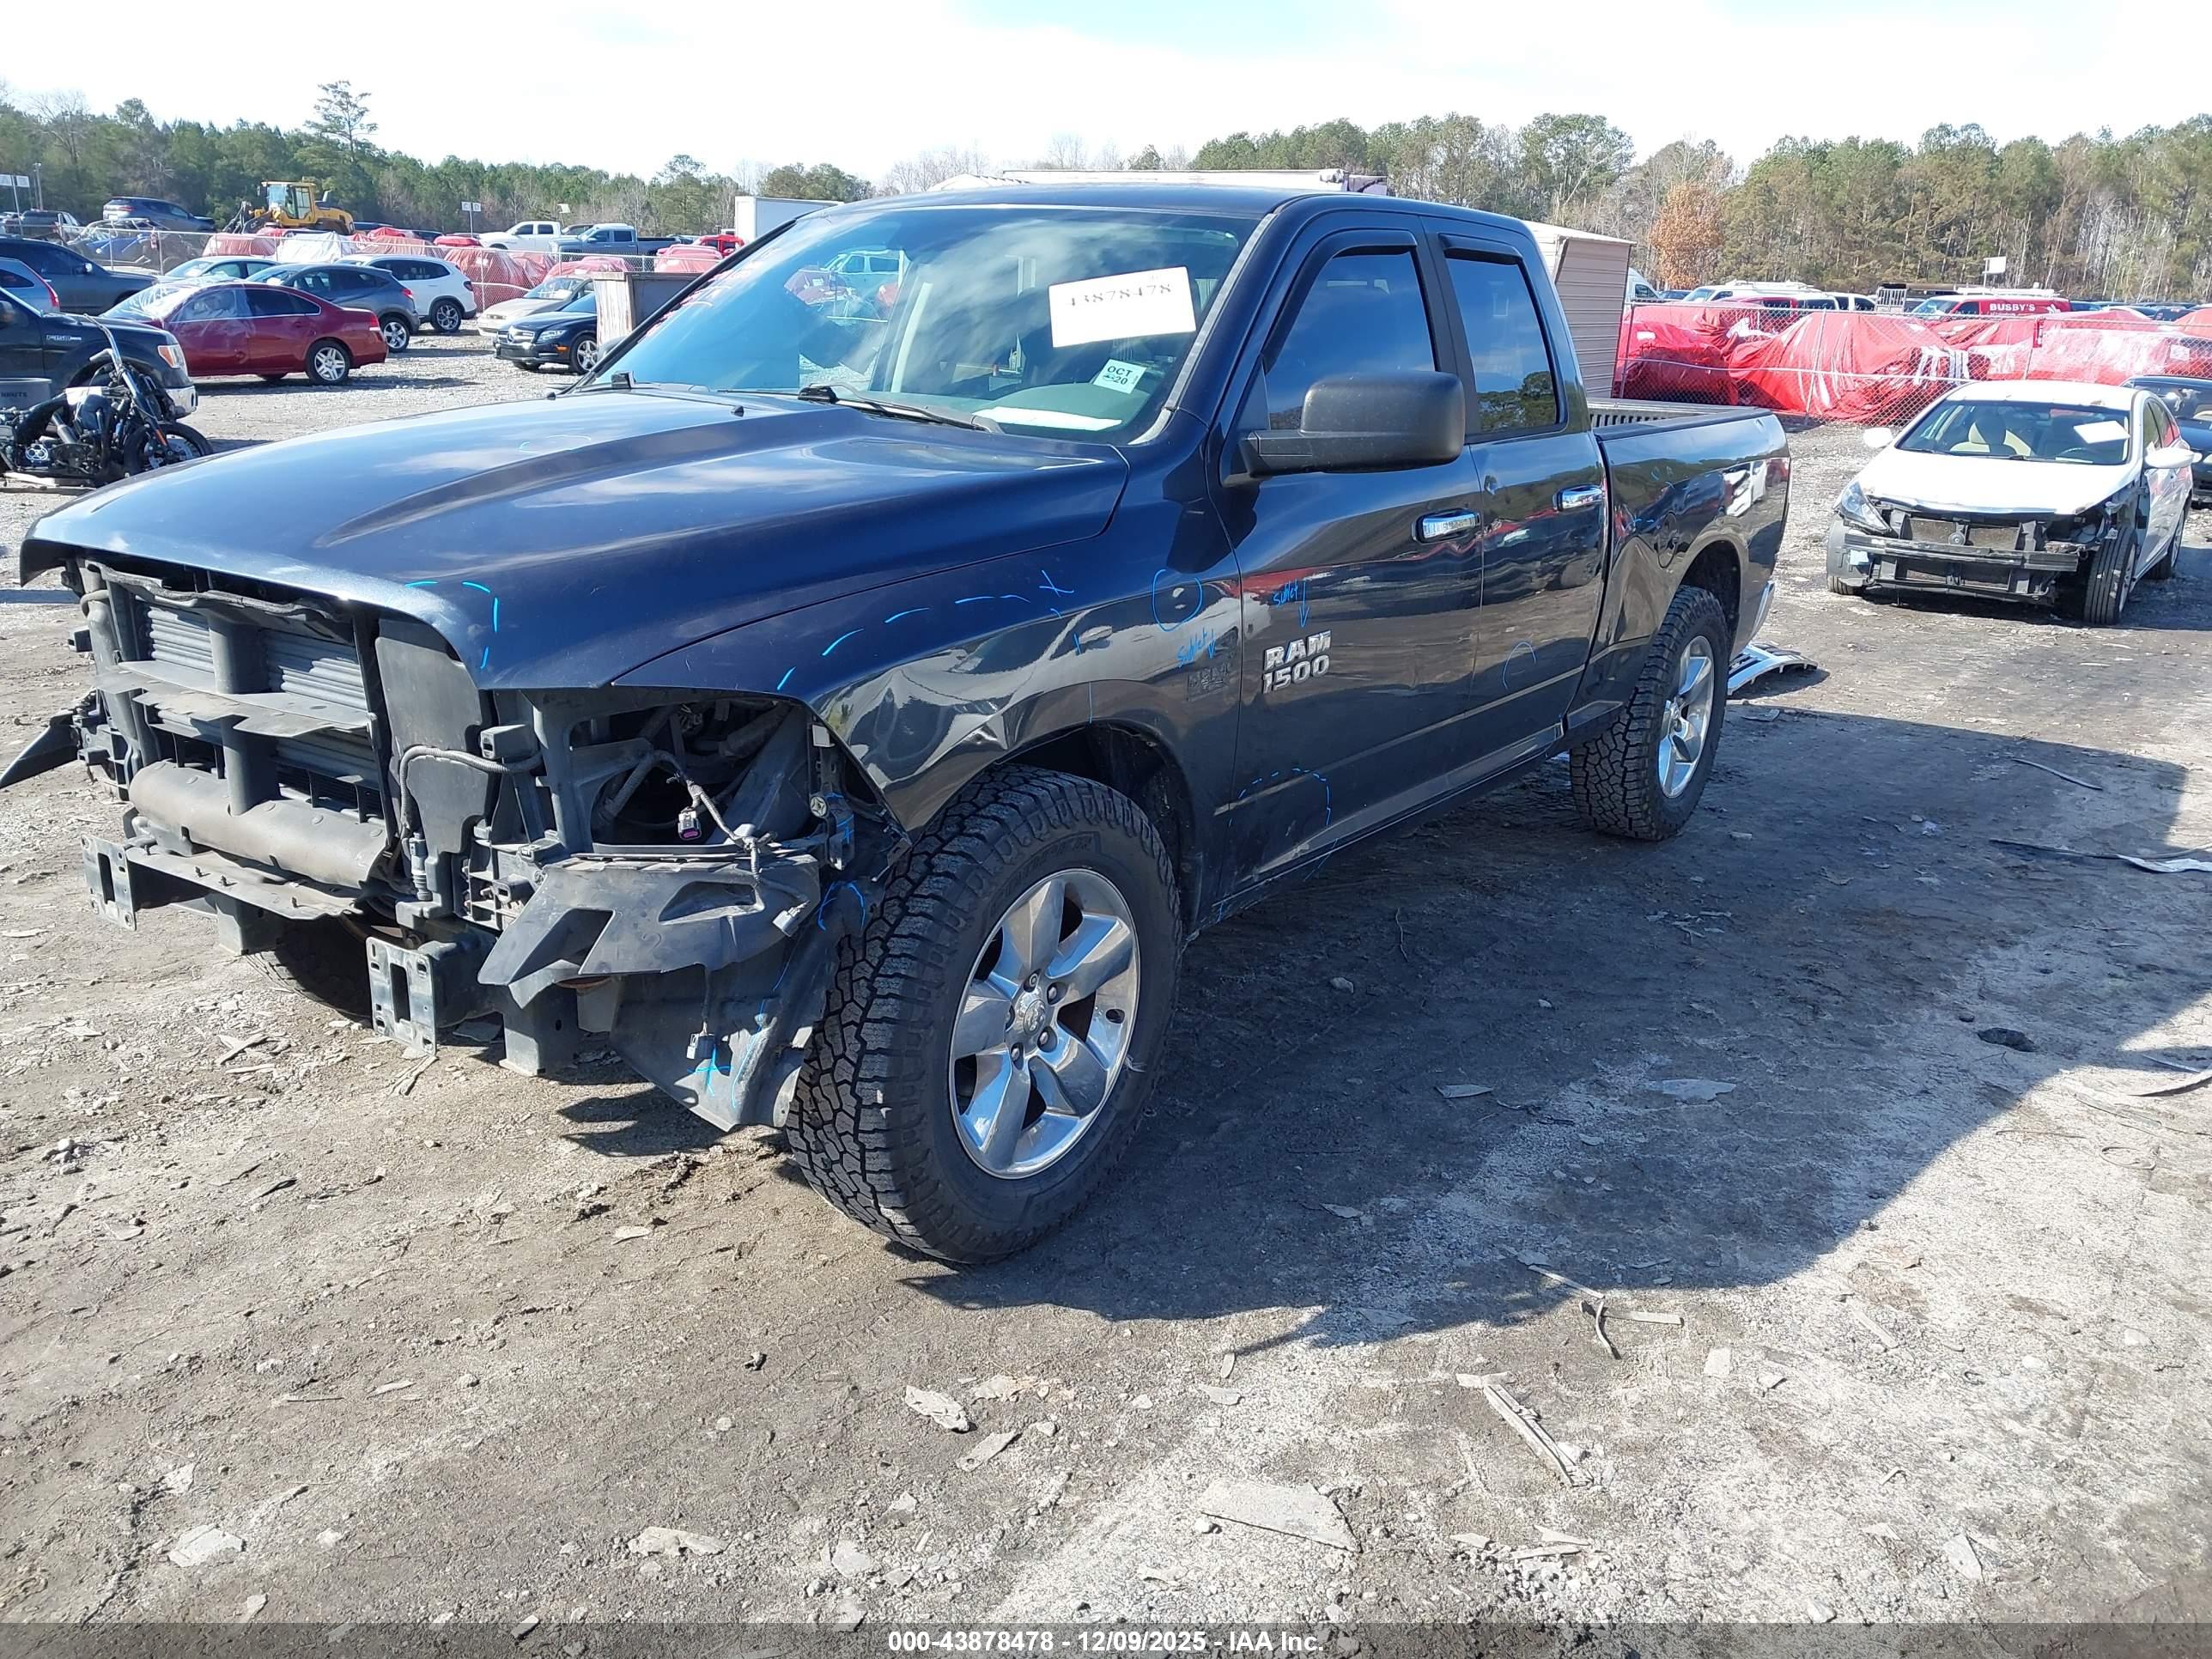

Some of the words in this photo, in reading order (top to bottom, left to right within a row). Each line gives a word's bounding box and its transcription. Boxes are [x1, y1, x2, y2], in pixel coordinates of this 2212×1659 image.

[1989, 302, 2036, 312] BUSBY'S
[1107, 365, 1133, 377] OCT
[1113, 376, 1128, 386] 20
[1263, 630, 1332, 671] RAM
[1261, 654, 1330, 694] 1500
